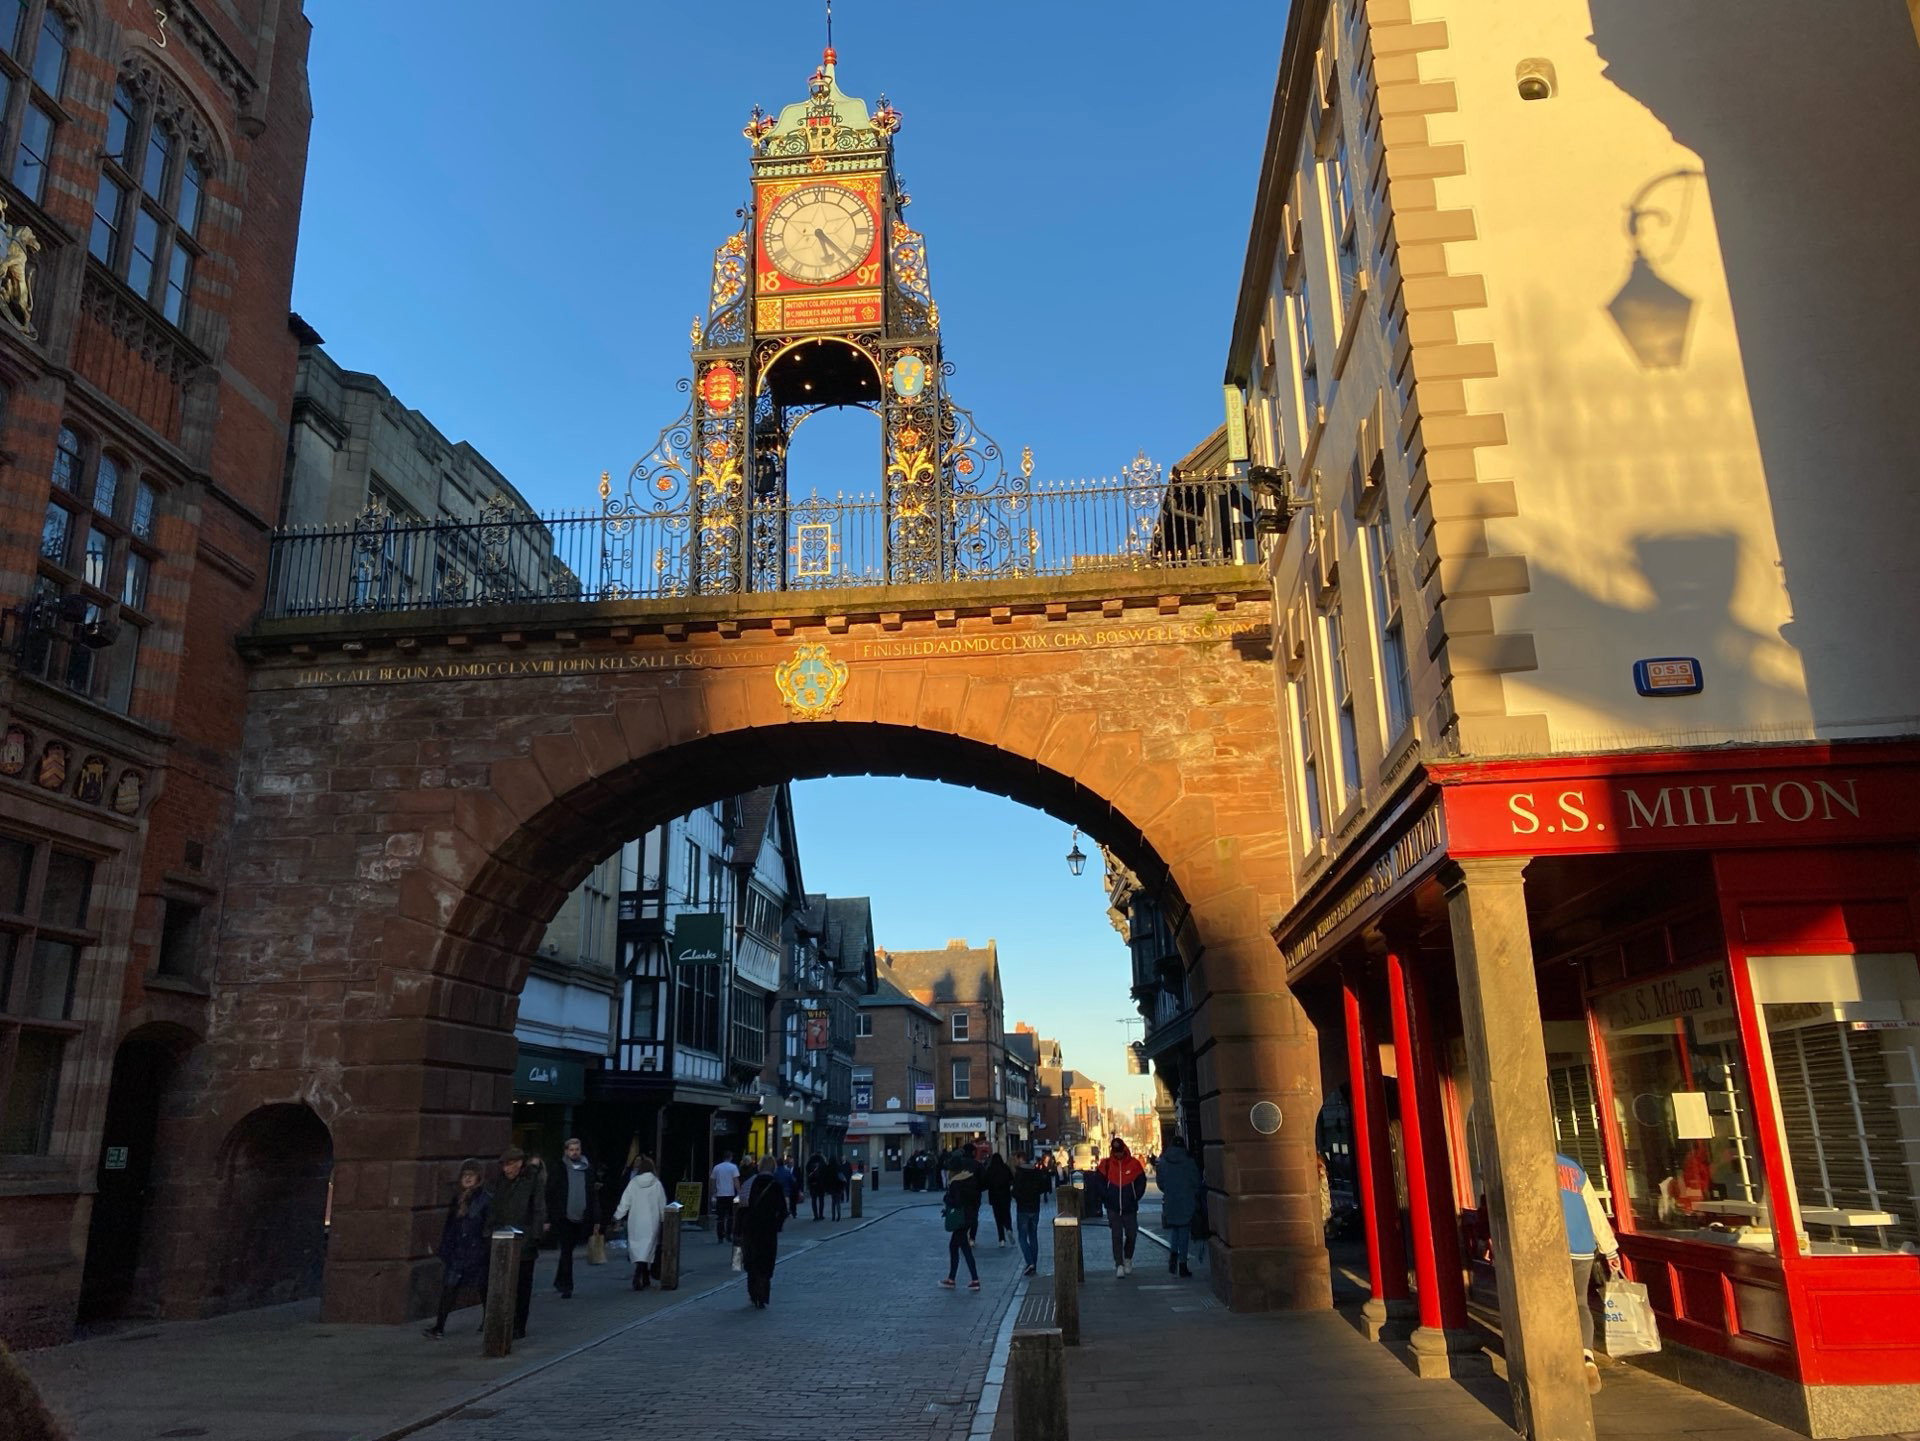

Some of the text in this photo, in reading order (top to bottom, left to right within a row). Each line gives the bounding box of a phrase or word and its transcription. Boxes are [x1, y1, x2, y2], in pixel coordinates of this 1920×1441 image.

[759, 263, 880, 291] 18 97
[863, 641, 934, 658] FINISHED
[1096, 626, 1178, 645] BOSWELL
[557, 658, 596, 675] JOHN
[599, 655, 669, 670] KELSALL
[1508, 778, 1861, 834] S.S. MILTON
[1394, 804, 1441, 879] MILTON
[678, 948, 717, 960] Clarks
[1652, 980, 1704, 1017] Milton
[961, 1121, 982, 1129] ISLAND
